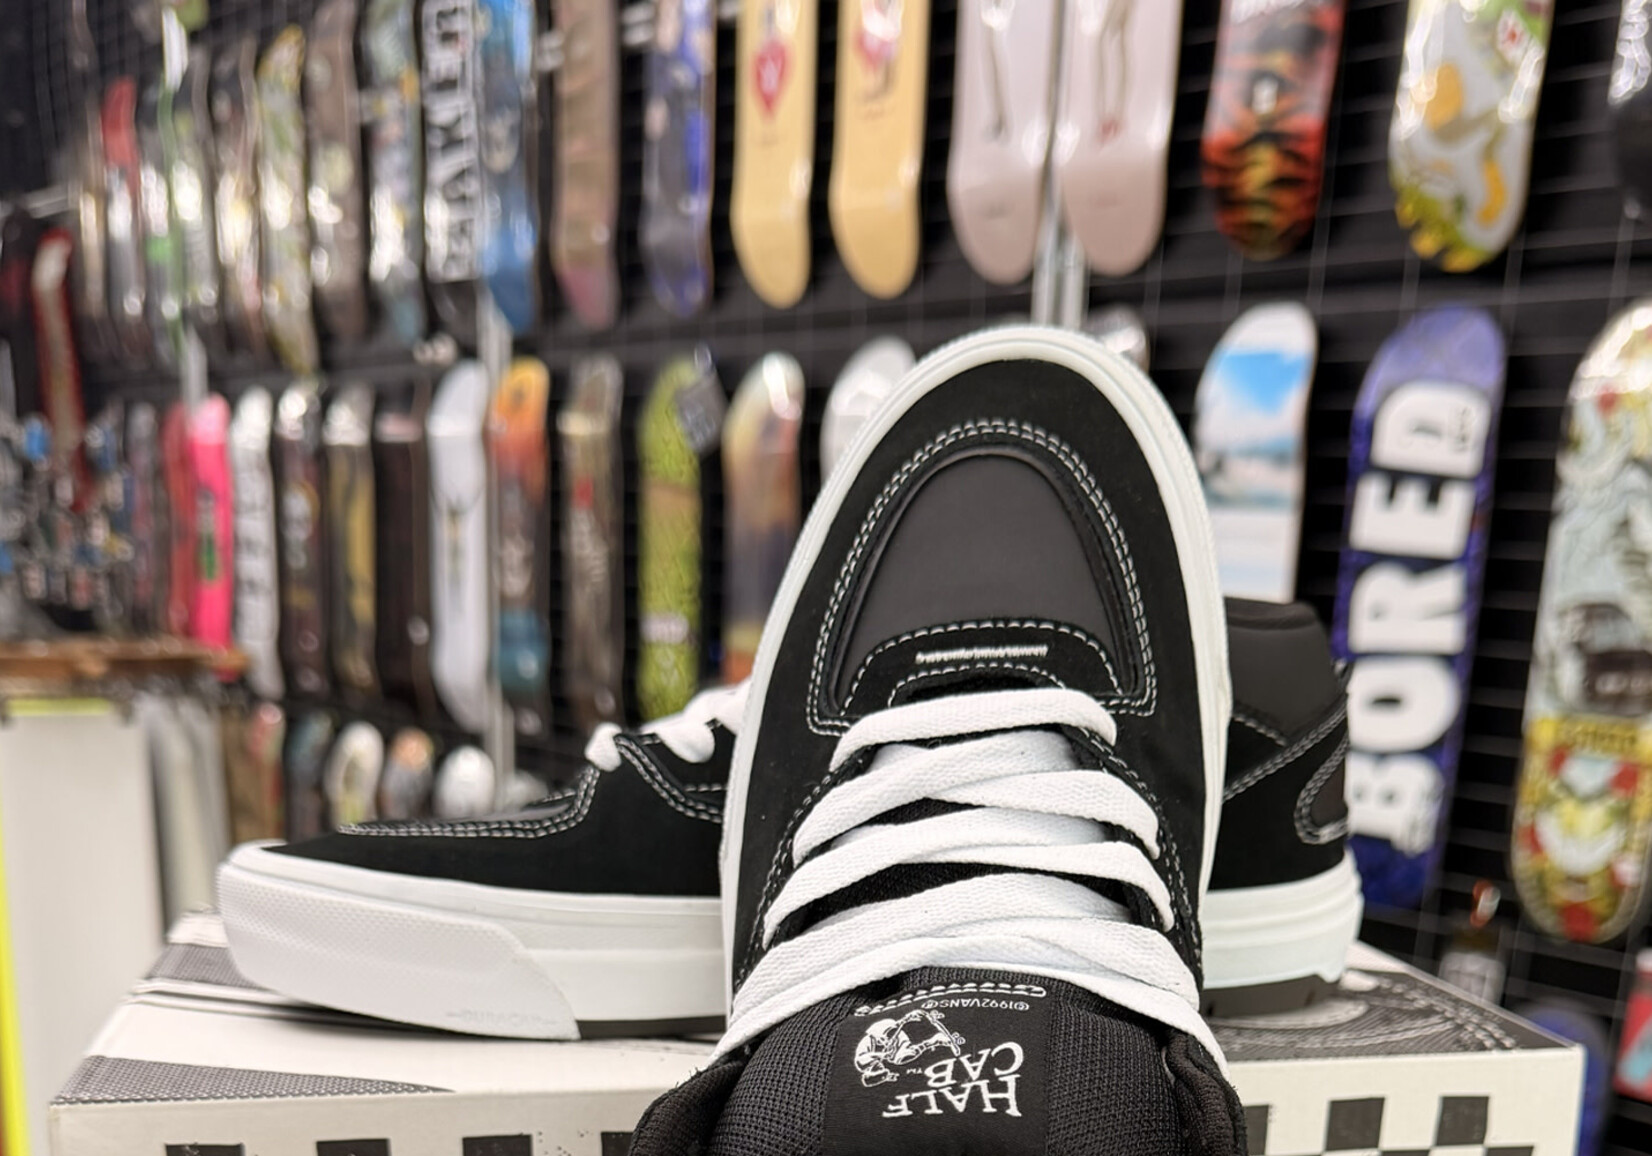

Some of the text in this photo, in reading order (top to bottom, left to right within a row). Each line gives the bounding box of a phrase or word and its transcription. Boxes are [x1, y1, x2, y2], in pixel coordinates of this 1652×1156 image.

[424, 0, 477, 281] AKER
[1344, 380, 1491, 857] BORED
[881, 1073, 1022, 1118] HALF
